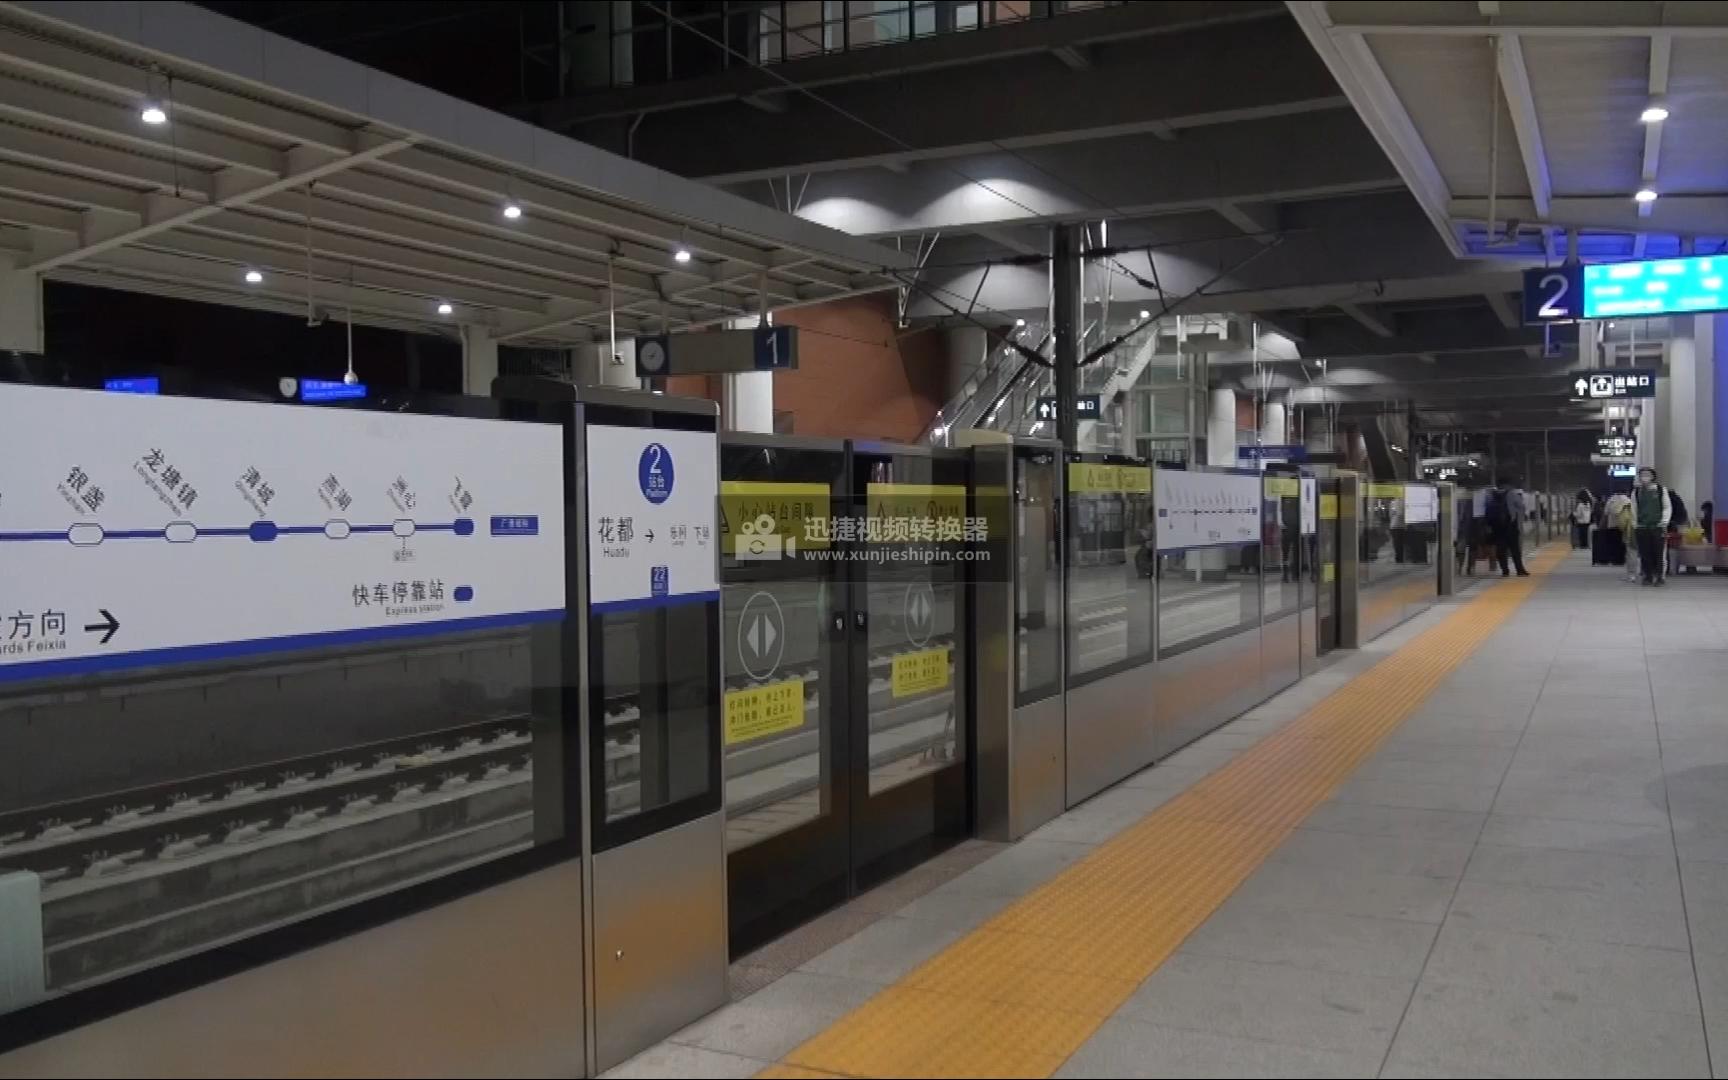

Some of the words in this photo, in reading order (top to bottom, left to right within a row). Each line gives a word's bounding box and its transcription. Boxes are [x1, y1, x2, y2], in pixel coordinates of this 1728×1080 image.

[1538, 274, 1569, 317] 2
[765, 331, 779, 365] 1
[649, 444, 662, 474] 2
[598, 516, 635, 544] 花都
[603, 548, 630, 558] Huadu
[352, 578, 445, 607] 快车停靠站
[0, 608, 67, 641] 方向
[27, 638, 67, 653] Feixia
